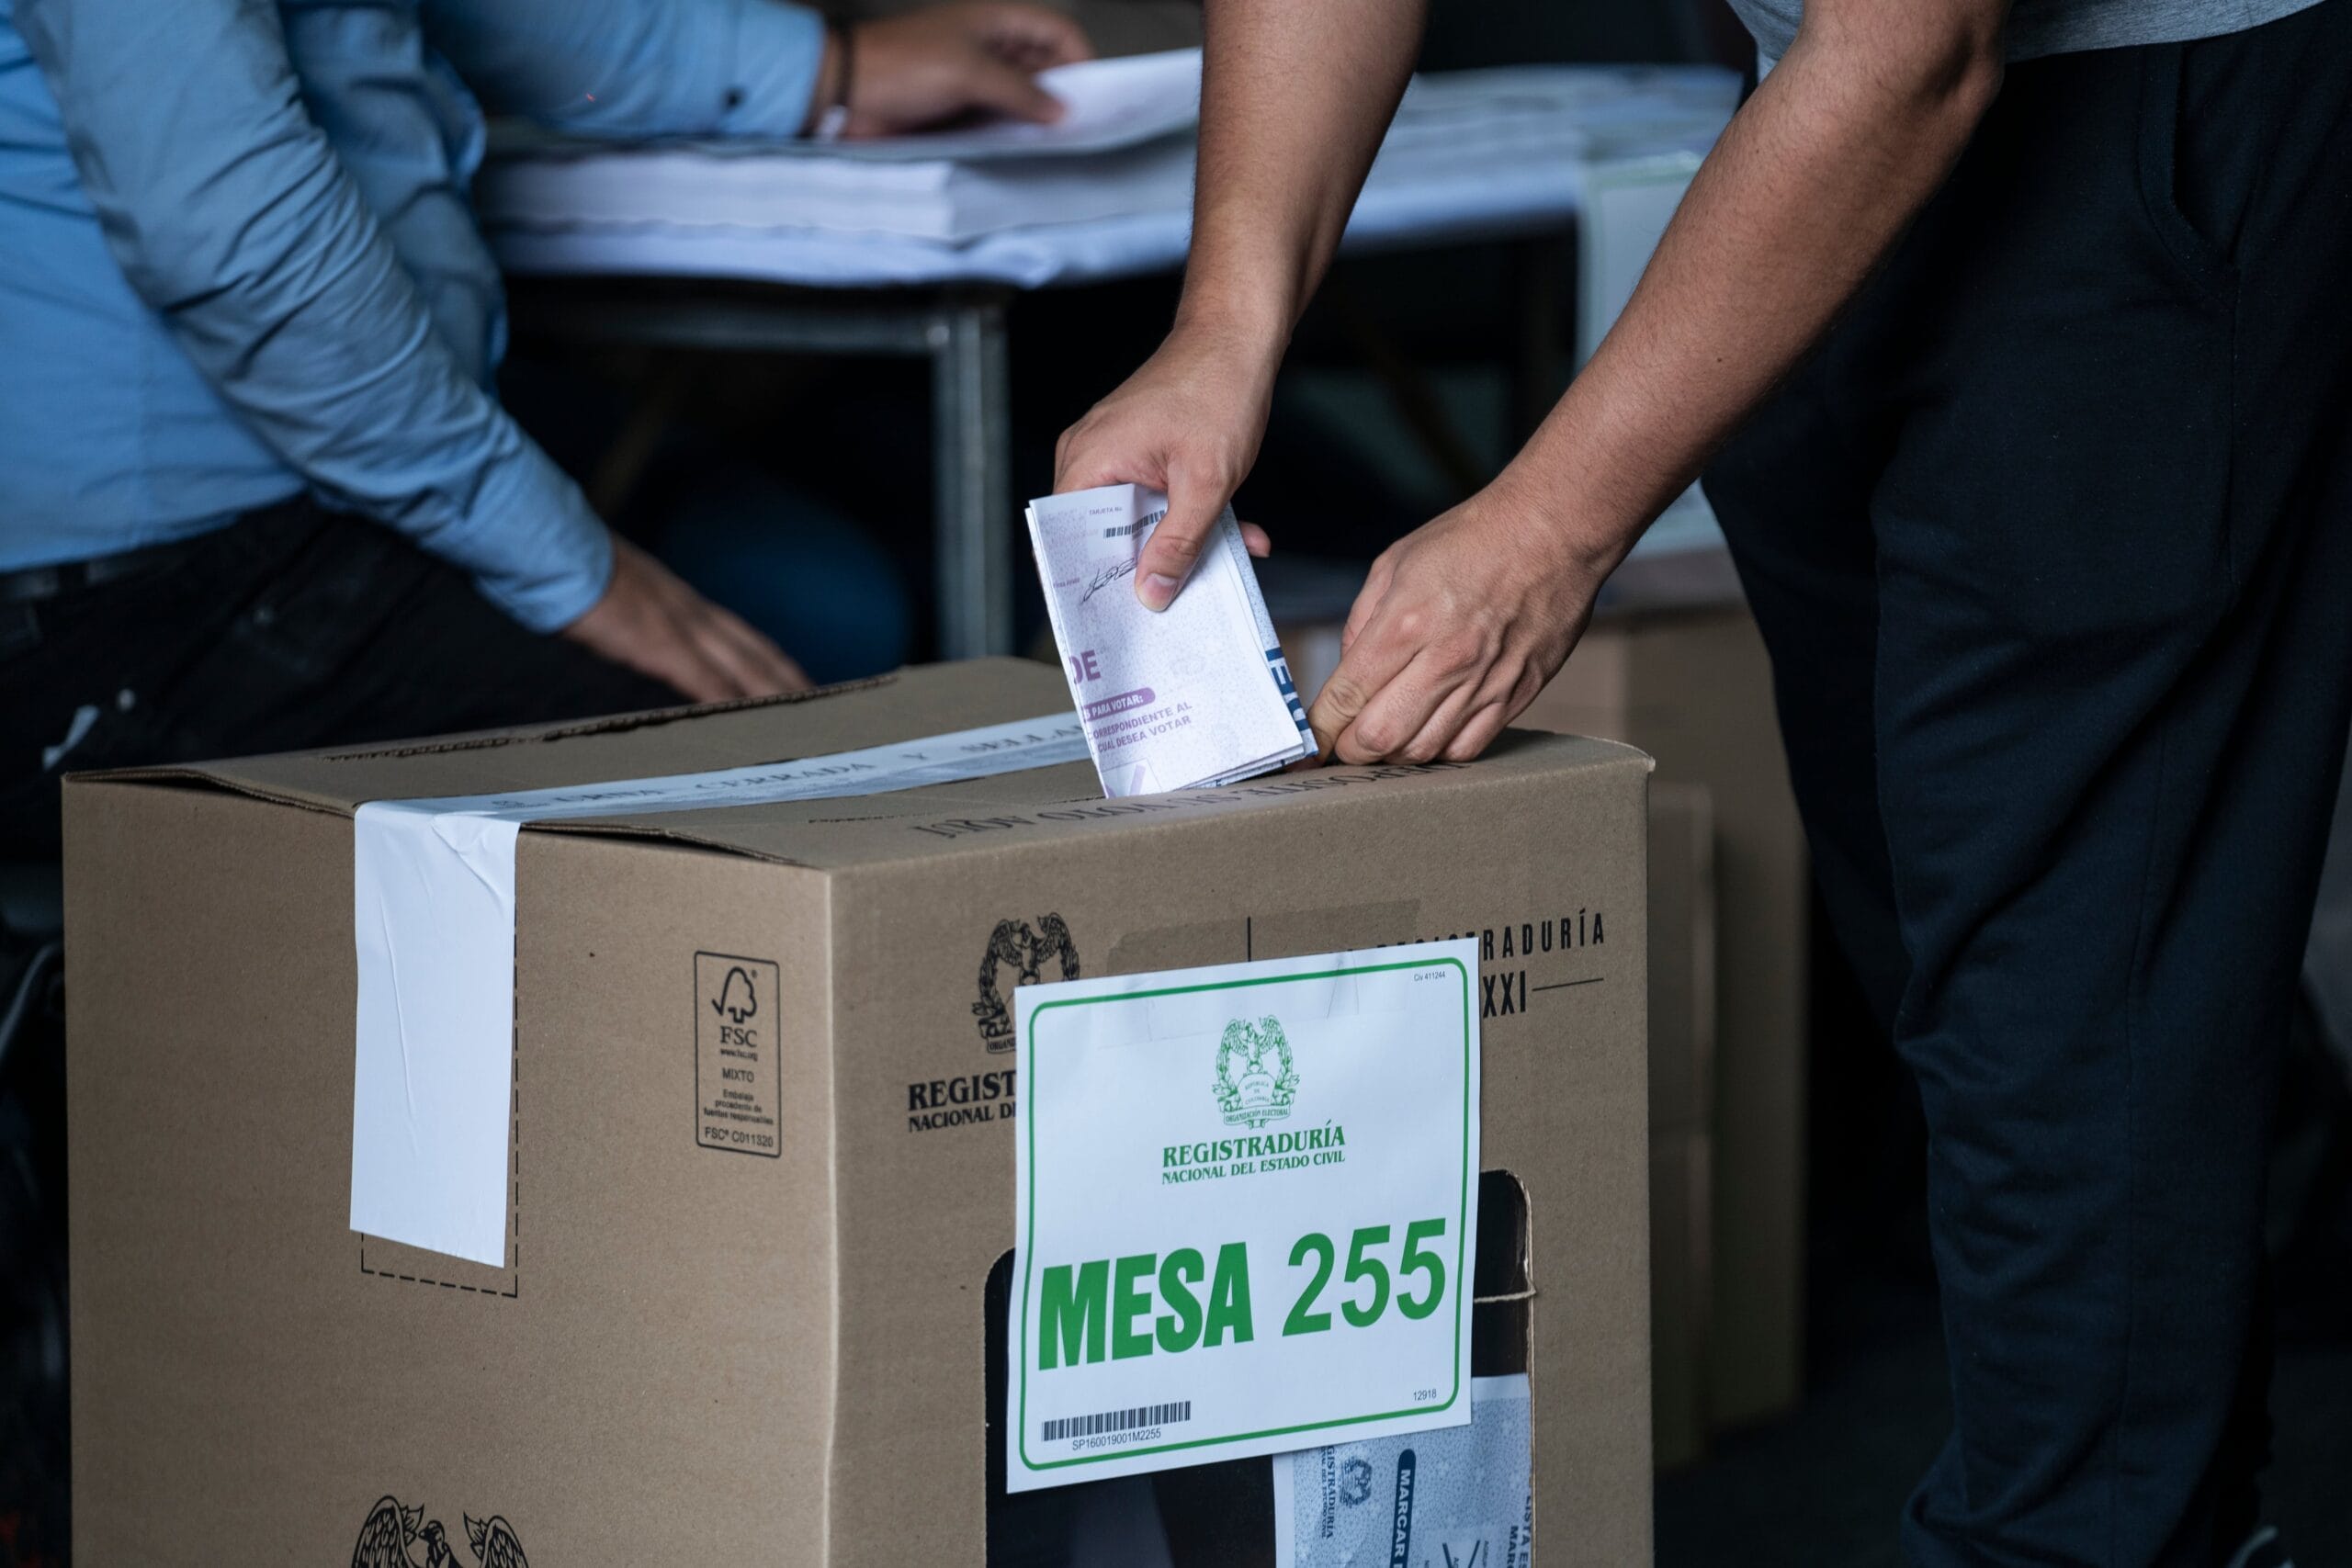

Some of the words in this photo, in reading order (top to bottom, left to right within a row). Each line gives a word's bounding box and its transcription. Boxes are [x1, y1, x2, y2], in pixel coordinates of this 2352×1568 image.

[1091, 705, 1110, 716] PARA
[1111, 694, 1143, 711] VOTAR:
[1177, 702, 1193, 713] AL
[1097, 740, 1115, 753] CUAL
[1116, 731, 1147, 747] DESEA
[1148, 716, 1192, 736] VOTAR
[695, 761, 876, 789] CERRADA
[1424, 971, 1446, 980] 411244
[1483, 970, 1527, 1019] XXI
[720, 1025, 758, 1047] FSC
[722, 1067, 754, 1083] MIXTO
[909, 1106, 994, 1133] NACIONAL
[732, 1131, 774, 1147] C011320
[1162, 1119, 1345, 1168] REGISTRADURÍA
[1162, 1165, 1227, 1185] NACIONAL
[1230, 1162, 1256, 1176] DEL
[1261, 1155, 1309, 1172] ESTADO
[1313, 1150, 1345, 1166] CIVIL
[1038, 1241, 1254, 1371] MESA
[1282, 1217, 1446, 1337] 255
[1413, 1389, 1437, 1401] 12918
[1072, 1428, 1161, 1450] SP160019001M2255
[1394, 1470, 1411, 1558] MARCAR
